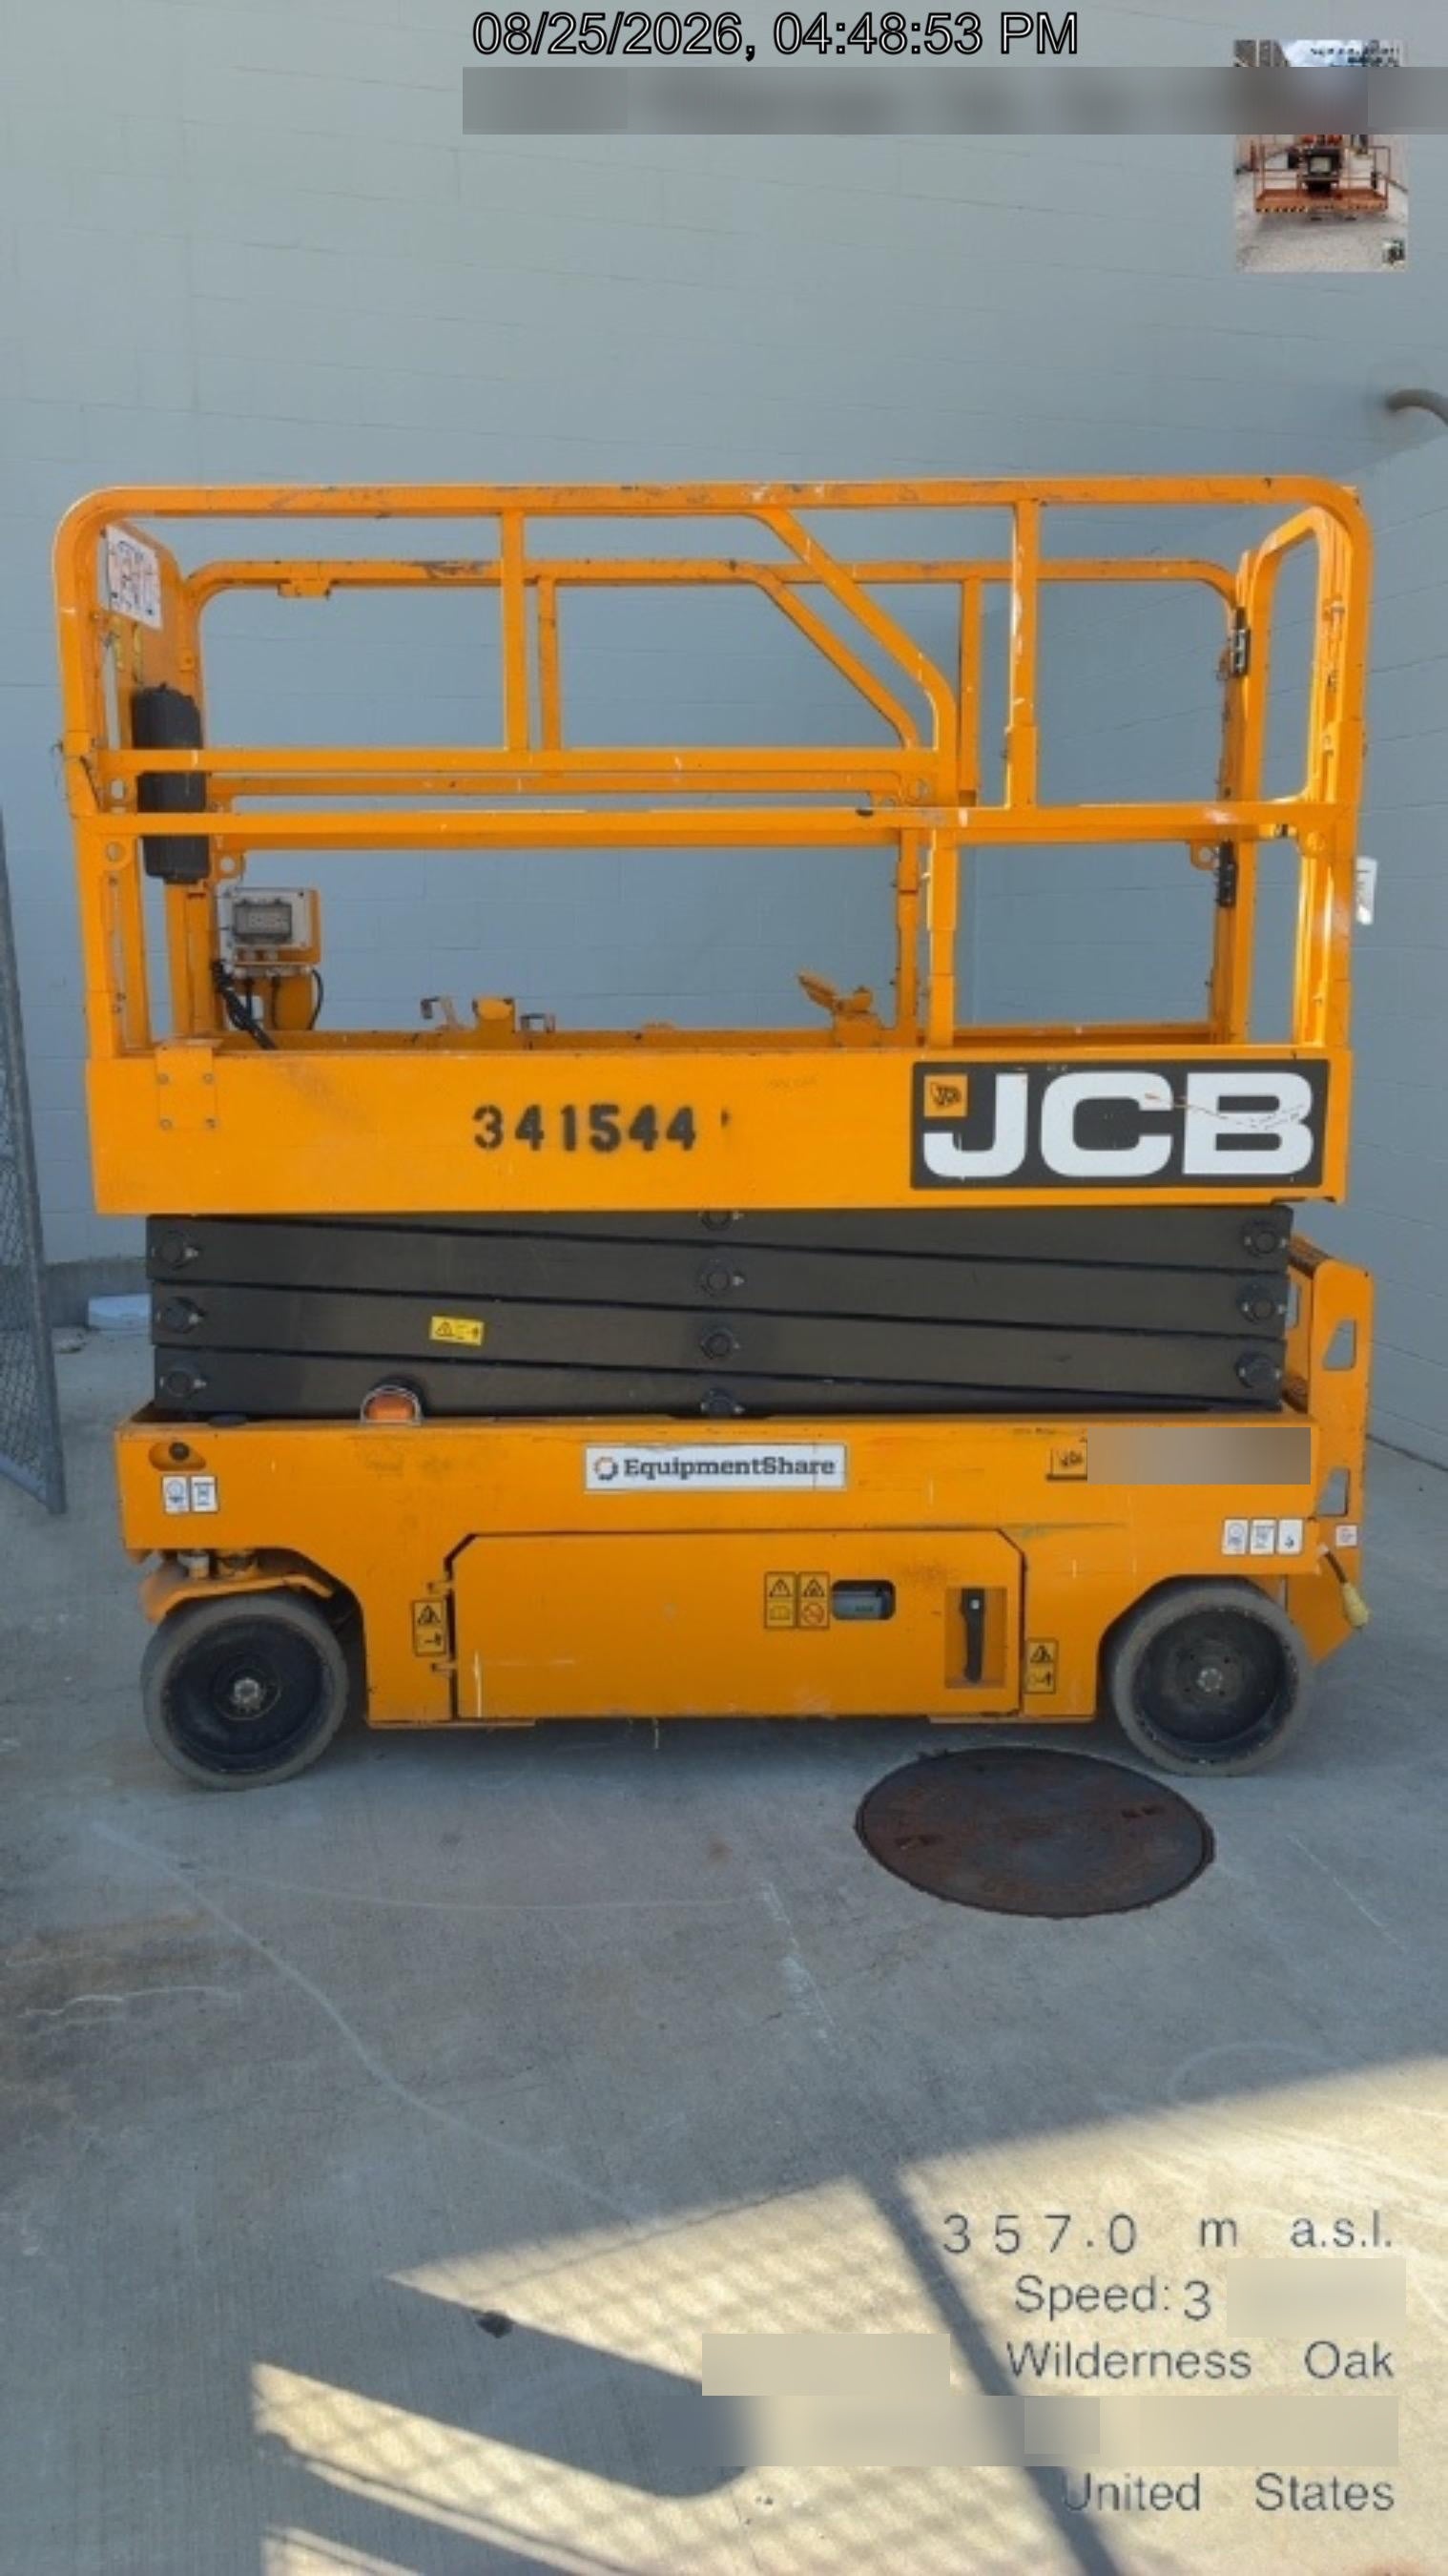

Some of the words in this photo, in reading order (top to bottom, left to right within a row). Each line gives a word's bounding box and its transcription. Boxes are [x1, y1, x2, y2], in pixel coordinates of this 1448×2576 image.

[473, 1103, 696, 1153] 341544
[923, 1071, 1314, 1178] JCB
[623, 1456, 836, 1480] EquipmentShare
